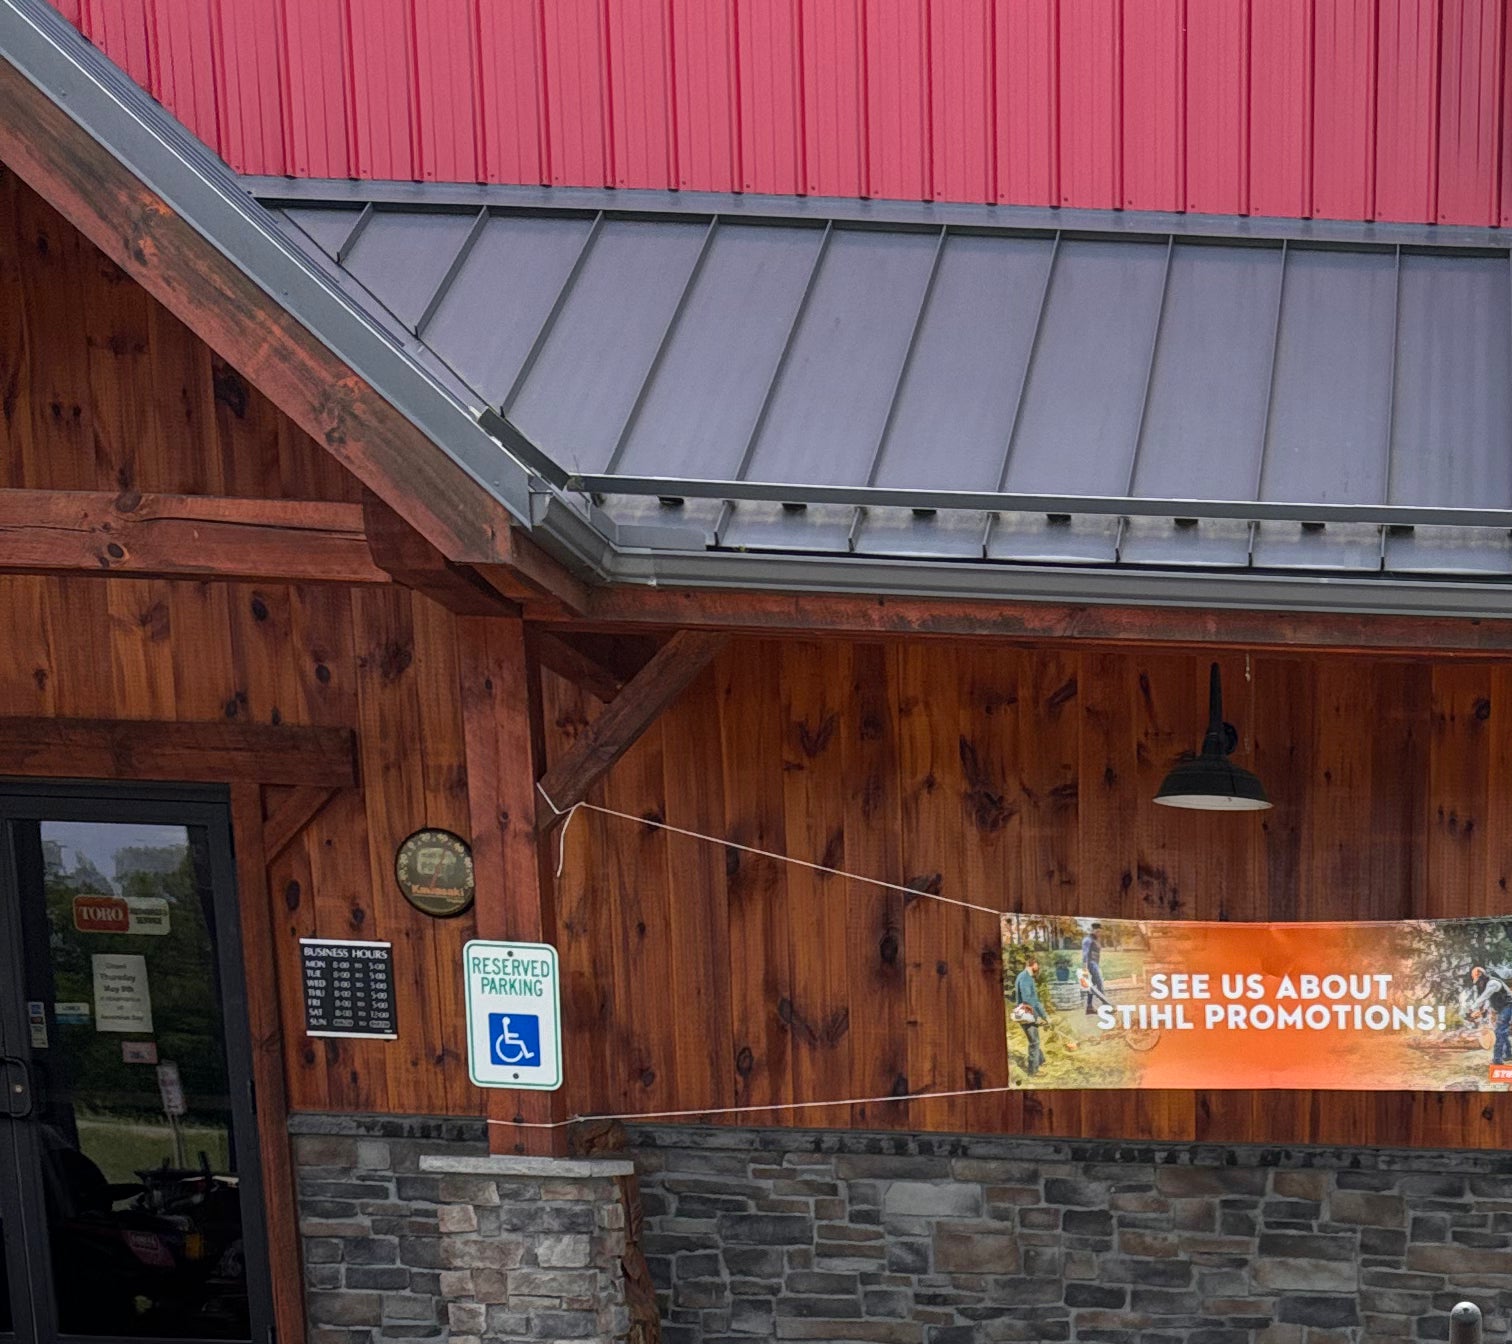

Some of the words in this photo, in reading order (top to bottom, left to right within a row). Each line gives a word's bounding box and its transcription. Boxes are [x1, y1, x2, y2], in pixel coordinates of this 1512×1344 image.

[78, 906, 124, 921] TORO
[303, 947, 349, 958] BUSINESS
[352, 949, 388, 959] HOURS
[305, 960, 326, 968] MON
[472, 957, 550, 978] RESERVED
[307, 989, 325, 997] THU
[481, 977, 543, 997] PARKING
[1150, 974, 1211, 1000] SEE
[1222, 974, 1265, 1000] US
[1275, 974, 1393, 1000] ABOUT
[309, 1018, 327, 1026] SUN
[1097, 1004, 1194, 1030] STIHL
[1205, 1003, 1447, 1030] PROMOTIONS!
